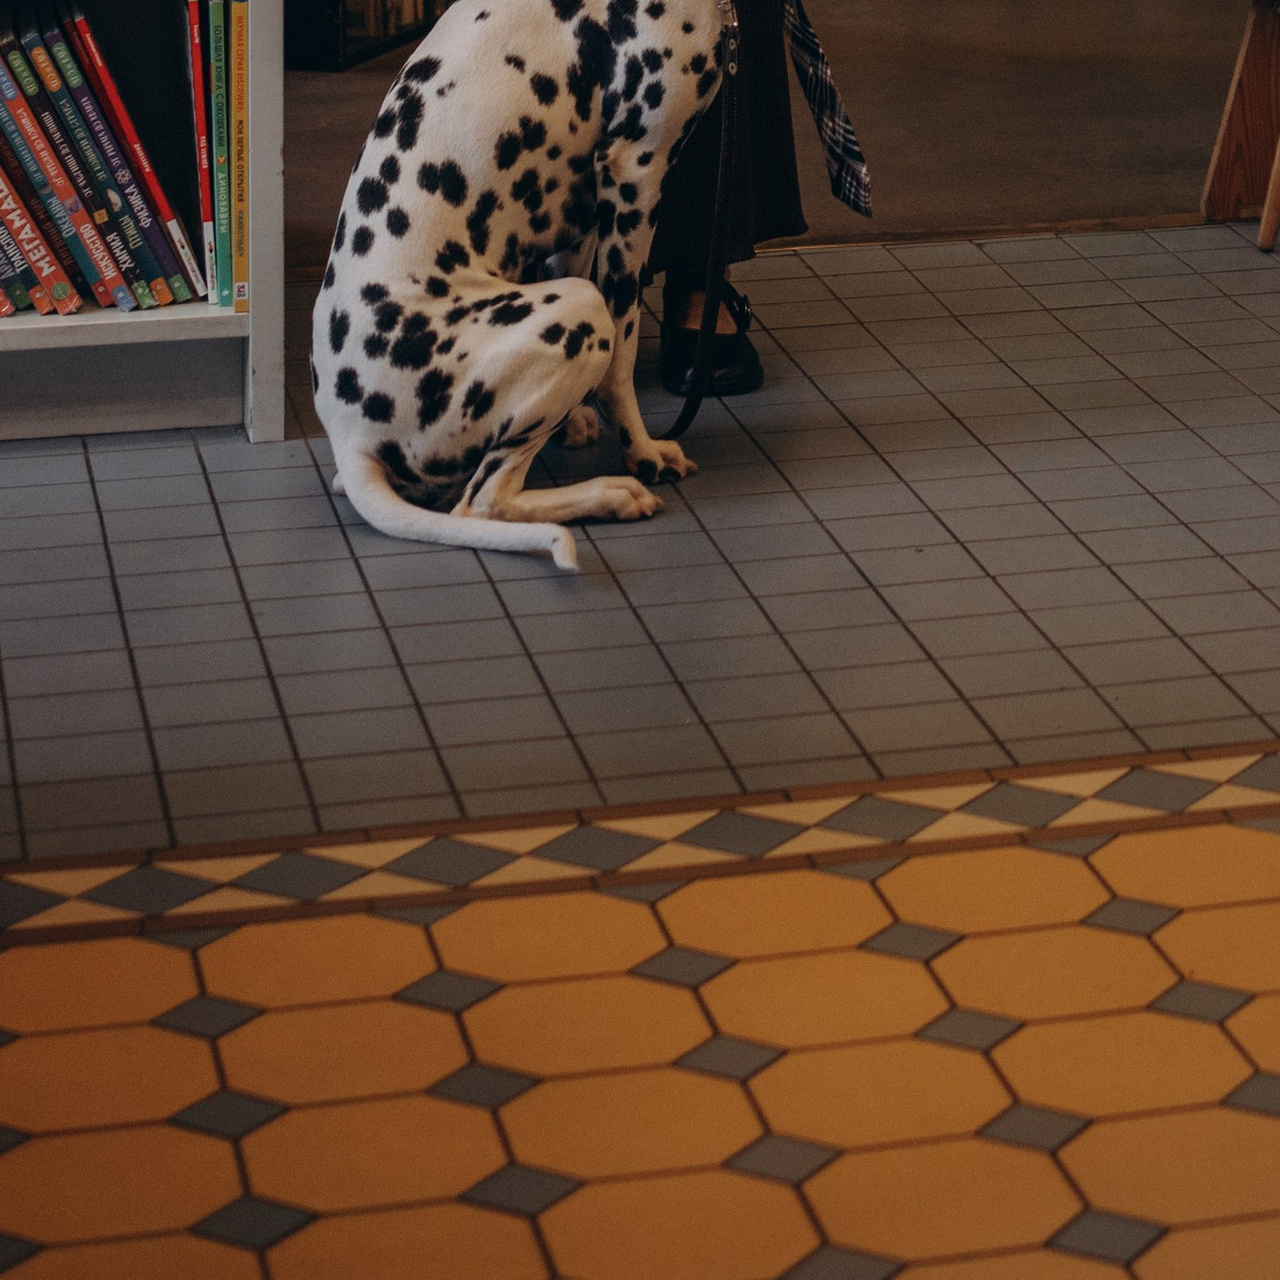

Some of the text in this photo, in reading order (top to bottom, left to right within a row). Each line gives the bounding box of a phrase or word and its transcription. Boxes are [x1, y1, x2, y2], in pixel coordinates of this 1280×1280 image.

[215, 65, 224, 91] КНИГА
[216, 102, 226, 147] ОКОШКАМИ
[236, 119, 244, 133] МОИ
[237, 163, 245, 202] ОТКРЫТИЯ
[47, 197, 74, 237] ОКЕАНЫ
[122, 184, 152, 228] ФИЗИКА
[120, 214, 143, 249] ПТИЦЫ
[80, 224, 116, 279] ИСКУССТВО
[106, 232, 134, 271] ХИМИЯ
